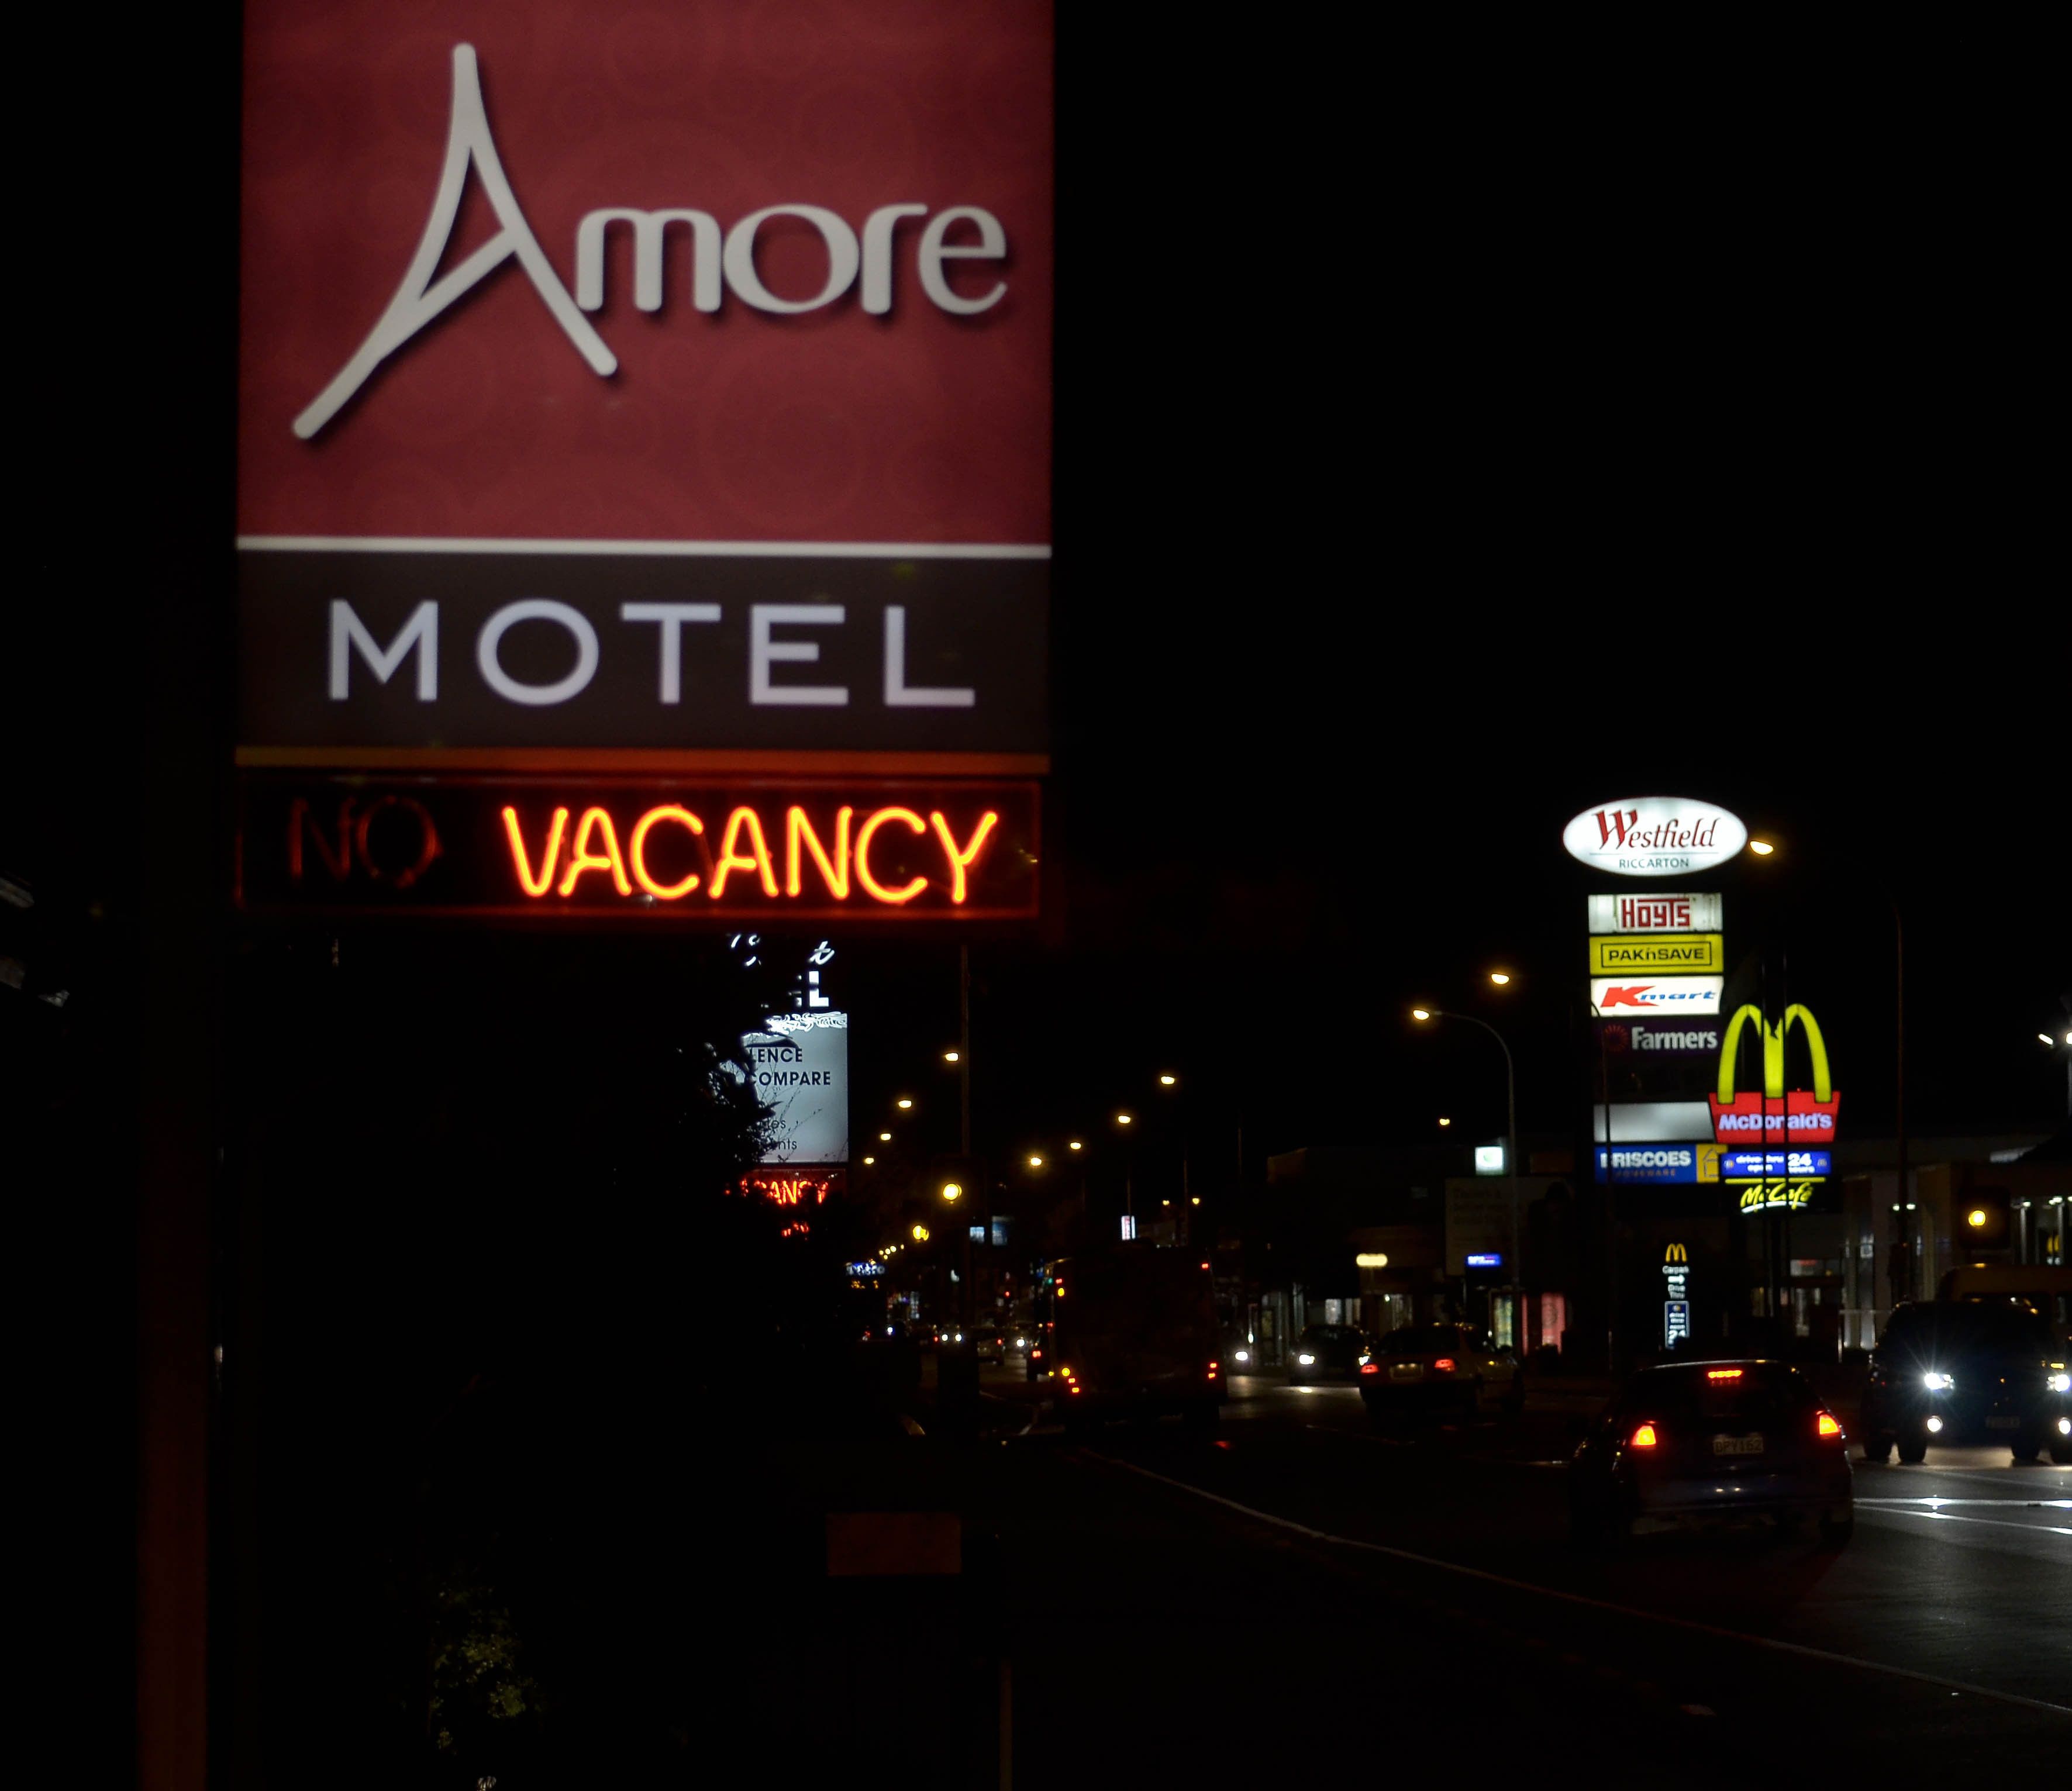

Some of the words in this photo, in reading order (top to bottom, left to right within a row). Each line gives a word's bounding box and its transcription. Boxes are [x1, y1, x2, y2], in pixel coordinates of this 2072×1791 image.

[292, 44, 1007, 439] Amore
[329, 599, 975, 706] MOTEL
[1592, 809, 1720, 850] Westfield
[502, 805, 997, 904] VACANCY
[1619, 858, 1689, 869] RICCARTON
[1600, 985, 1716, 1007] Kmart
[1631, 1026, 1718, 1050] Farmers
[1788, 1152, 1812, 1167] 24
